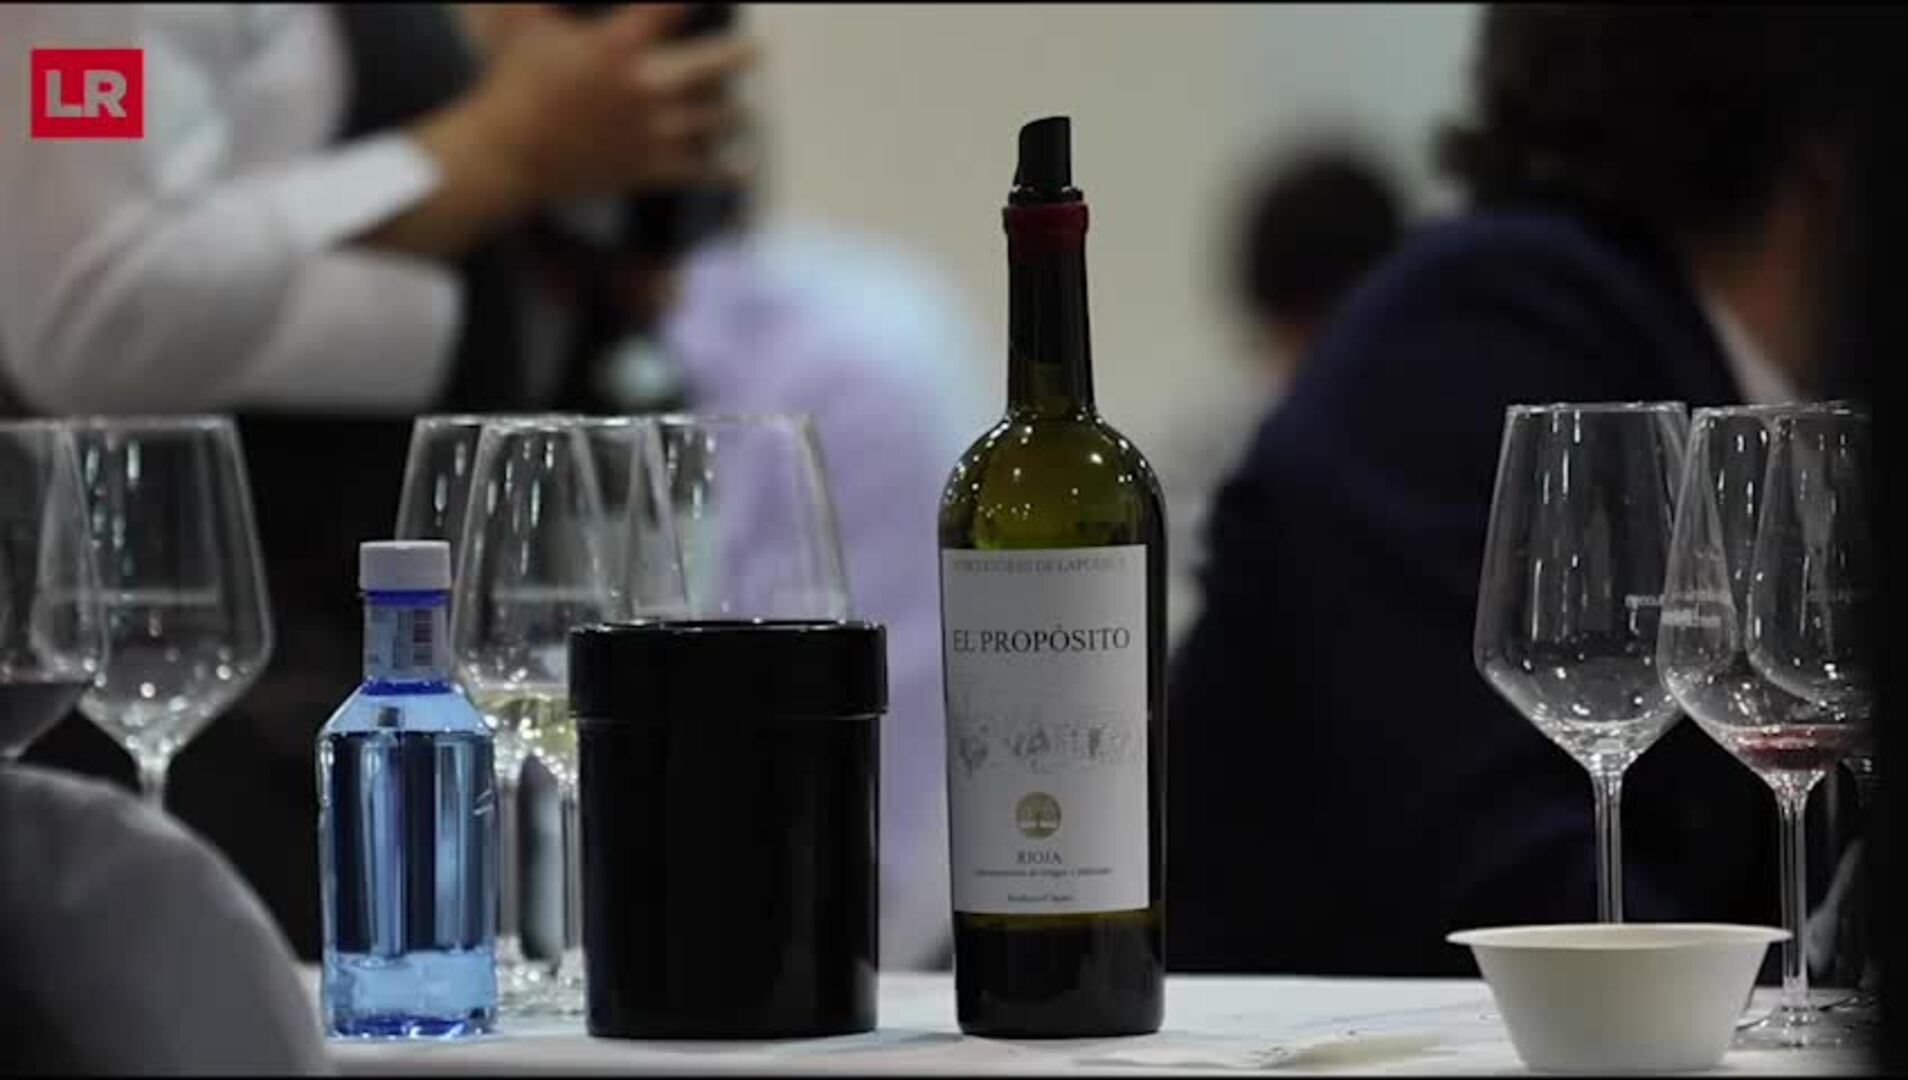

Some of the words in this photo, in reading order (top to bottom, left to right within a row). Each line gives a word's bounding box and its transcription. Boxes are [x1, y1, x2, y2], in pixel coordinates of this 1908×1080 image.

[952, 629, 976, 652] EL
[979, 623, 1131, 652] PROPÓSITO
[1015, 850, 1063, 865] RIOJA
